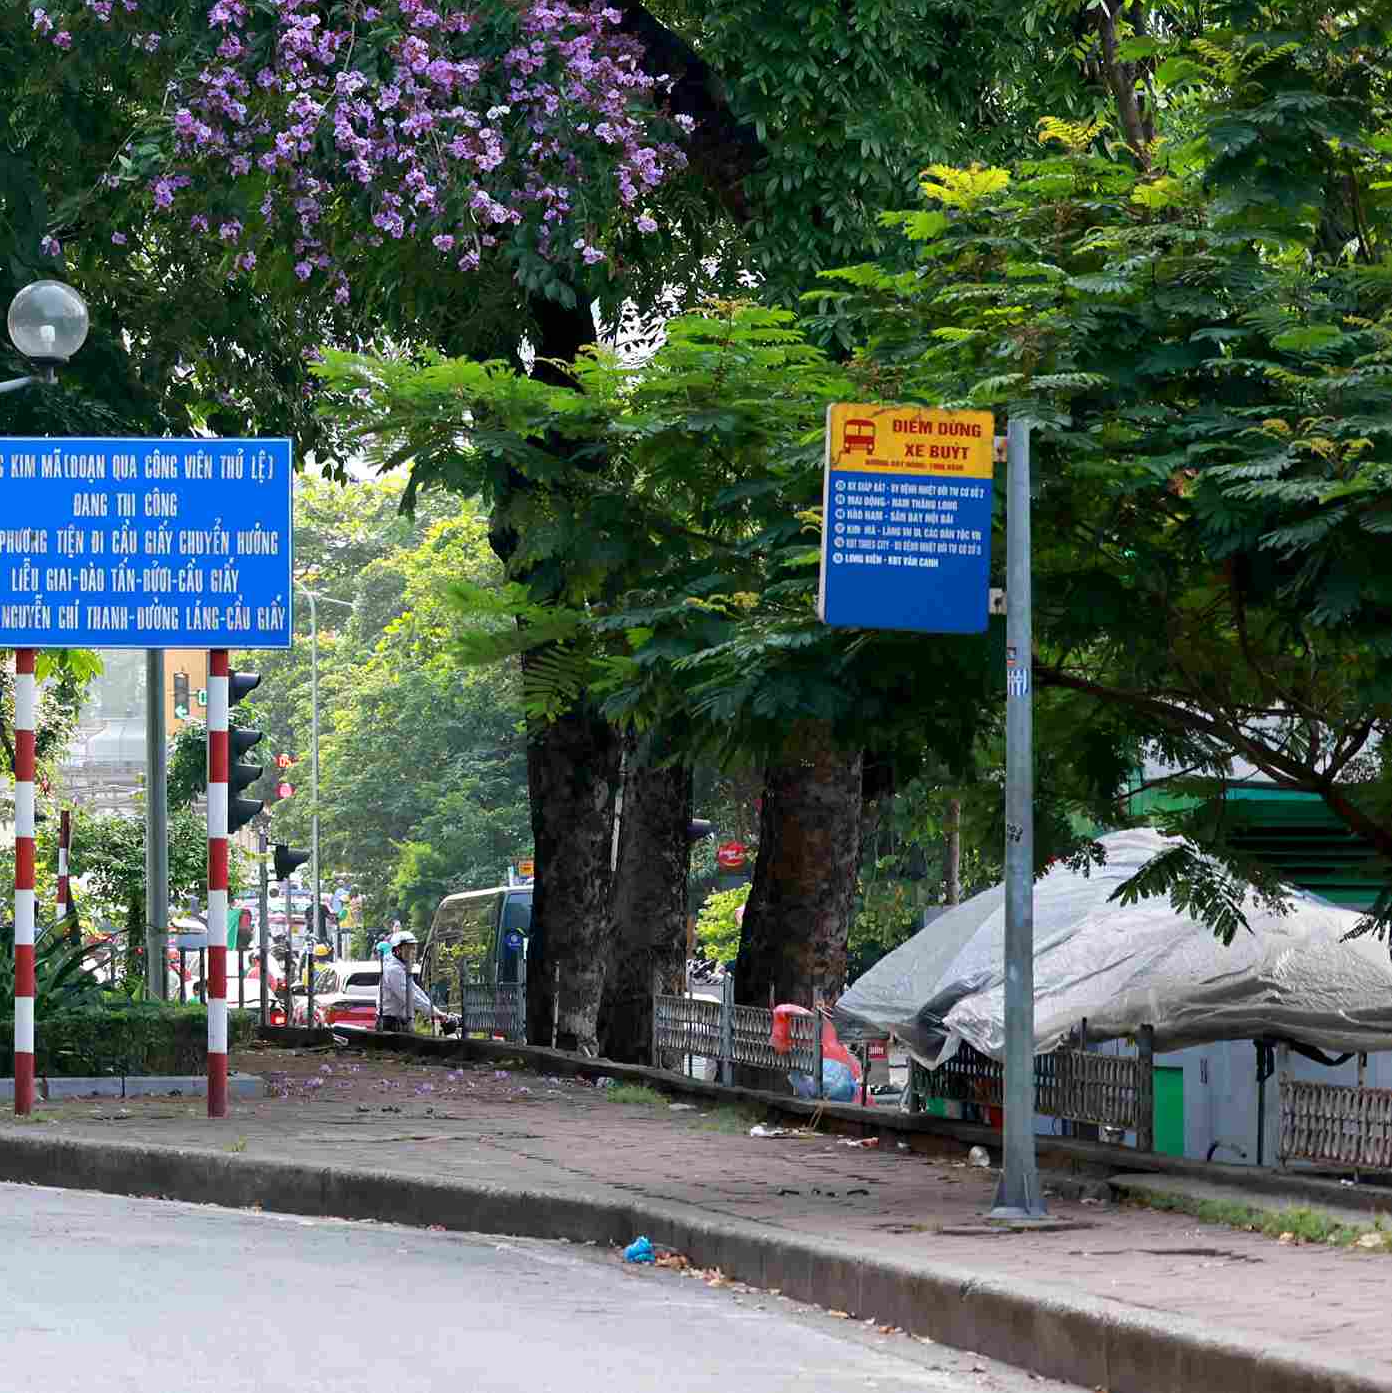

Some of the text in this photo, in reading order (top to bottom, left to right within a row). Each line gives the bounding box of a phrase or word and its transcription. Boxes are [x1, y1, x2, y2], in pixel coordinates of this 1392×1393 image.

[10, 454, 36, 479] KIM
[112, 454, 137, 481] QUA
[144, 448, 178, 479] CÔNG
[184, 448, 213, 479] VIÊN
[220, 447, 244, 479] THỦ
[904, 443, 925, 457] XE
[72, 487, 178, 517] ĐANG THI CÔNG
[56, 523, 85, 559] TIỆN
[90, 529, 104, 554] ĐI
[111, 518, 138, 555] CẦU
[144, 519, 174, 555] GIẤY
[179, 517, 229, 555] CHUYỂN
[237, 521, 279, 555] HƯỚNG
[11, 558, 39, 592] LIỄU
[210, 557, 239, 593] GIẤY
[1, 593, 51, 629] NGUYỄN
[58, 598, 79, 630] CHÍ
[257, 594, 286, 631] GIẤY
